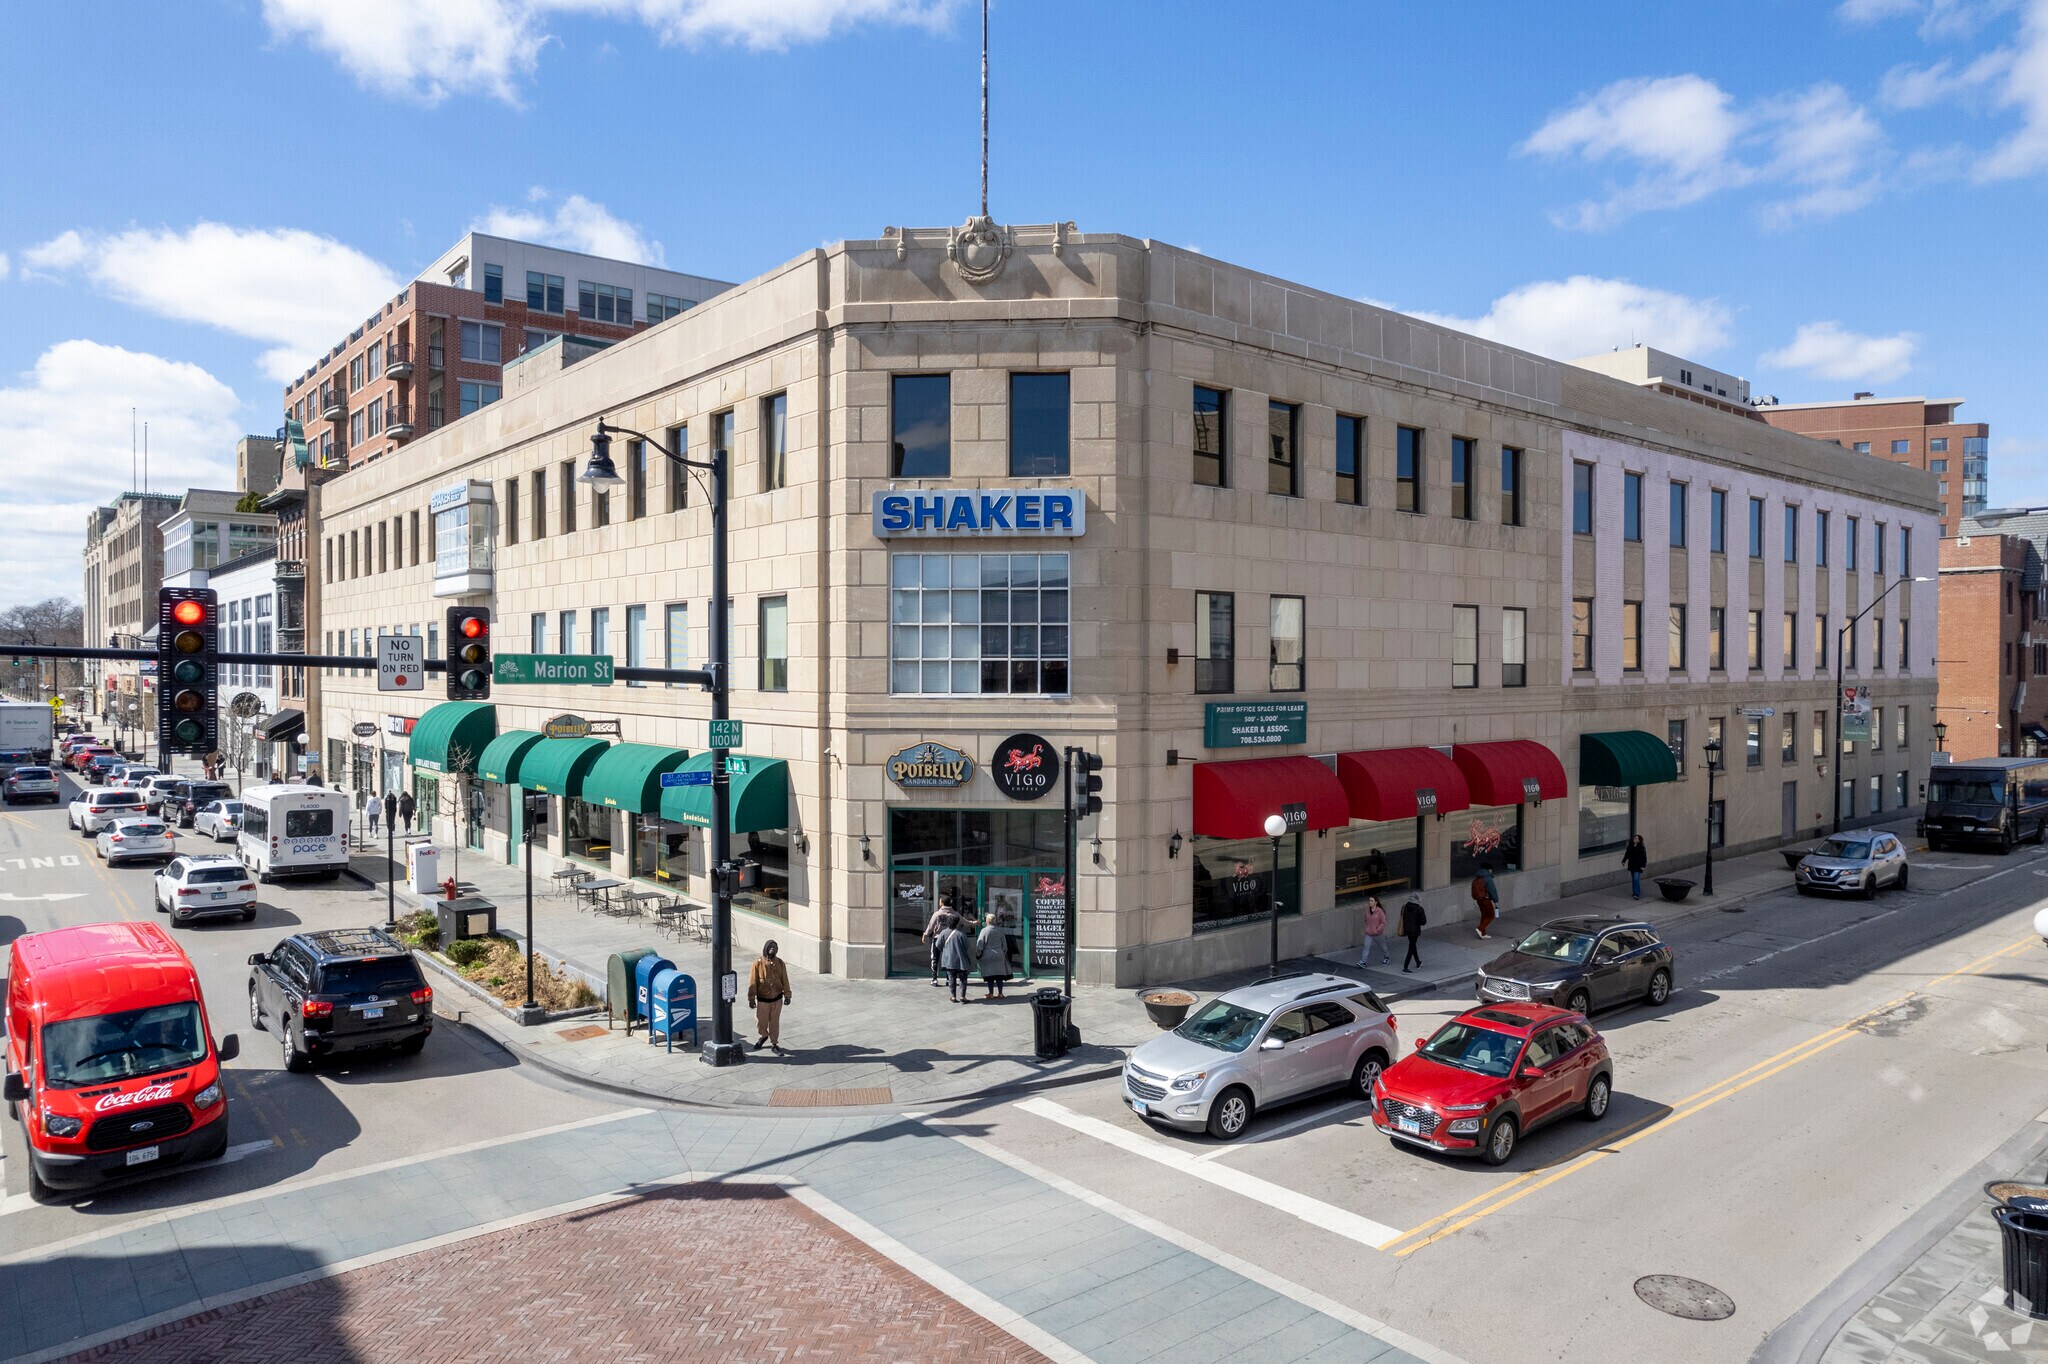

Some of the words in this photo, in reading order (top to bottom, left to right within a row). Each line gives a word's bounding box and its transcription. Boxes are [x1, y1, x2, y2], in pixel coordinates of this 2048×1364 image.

[882, 495, 1073, 530] SHAKER
[390, 640, 410, 651] NO
[388, 653, 414, 662] TURN
[382, 664, 396, 673] ON
[400, 664, 420, 673] RED
[534, 661, 587, 678] Marion
[594, 661, 609, 678] St
[549, 723, 587, 735] POTBELLY
[712, 722, 730, 734] 142
[732, 722, 740, 733] N
[1231, 726, 1259, 734] SHAKER
[1266, 725, 1290, 733] ASSOC.
[711, 735, 730, 746] 1100
[731, 735, 740, 746] W
[892, 760, 966, 781] POTBELLY
[1004, 774, 1046, 786] VIGO
[1524, 783, 1540, 793] VIGO
[1417, 795, 1437, 806] VIGO
[683, 812, 710, 824] Sandwiches
[1283, 811, 1307, 822] VIGO
[293, 844, 327, 855] pace
[0, 855, 81, 871] ONL
[1232, 880, 1257, 893] VIGO
[95, 1082, 176, 1112] Coca-Cola
